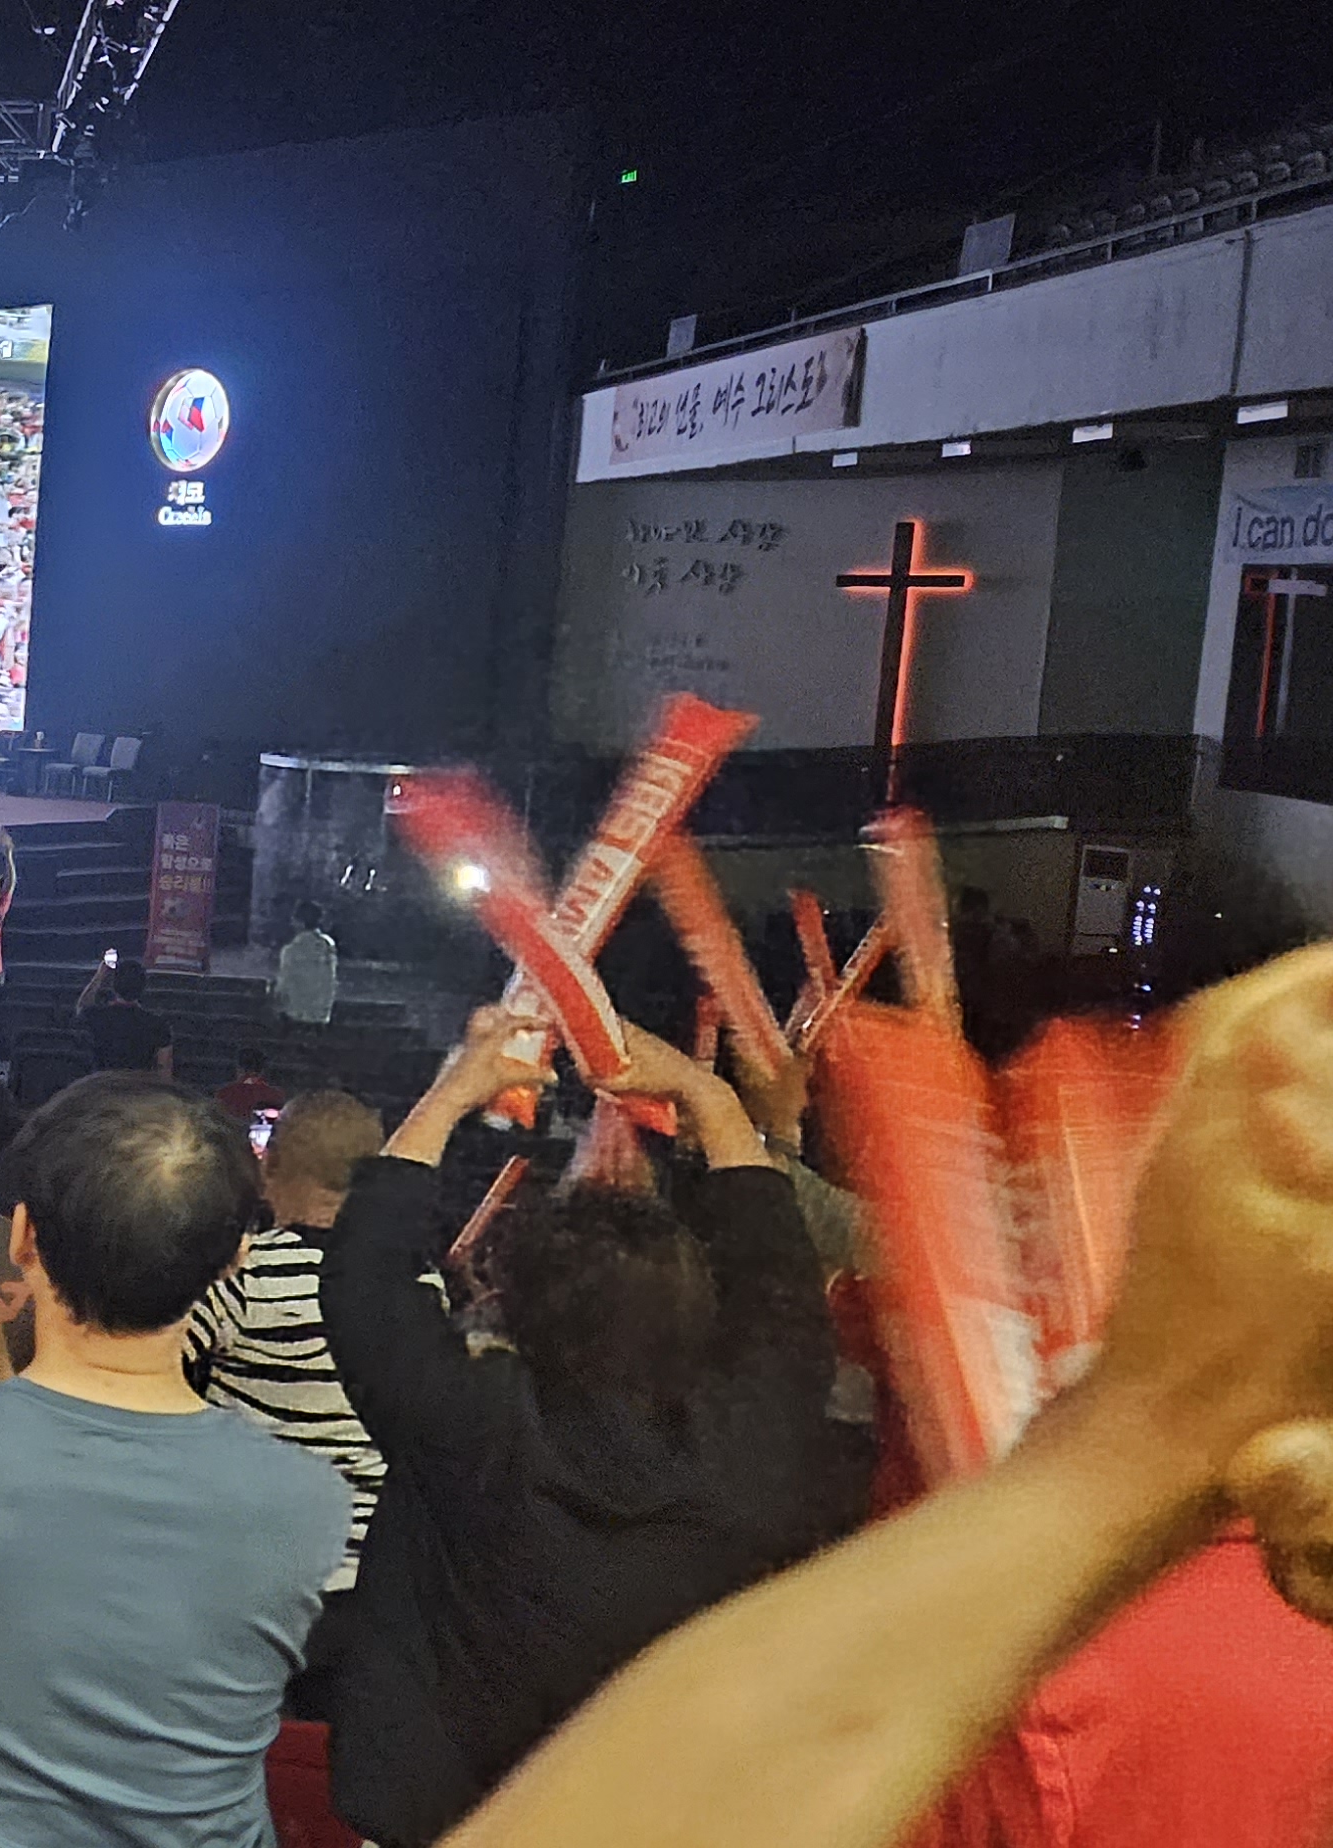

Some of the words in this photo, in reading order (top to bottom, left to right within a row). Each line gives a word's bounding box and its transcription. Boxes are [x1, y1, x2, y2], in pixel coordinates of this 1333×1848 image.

[750, 356, 816, 418] 그리스도
[1247, 515, 1295, 550] can
[160, 853, 213, 872] 함성으로
